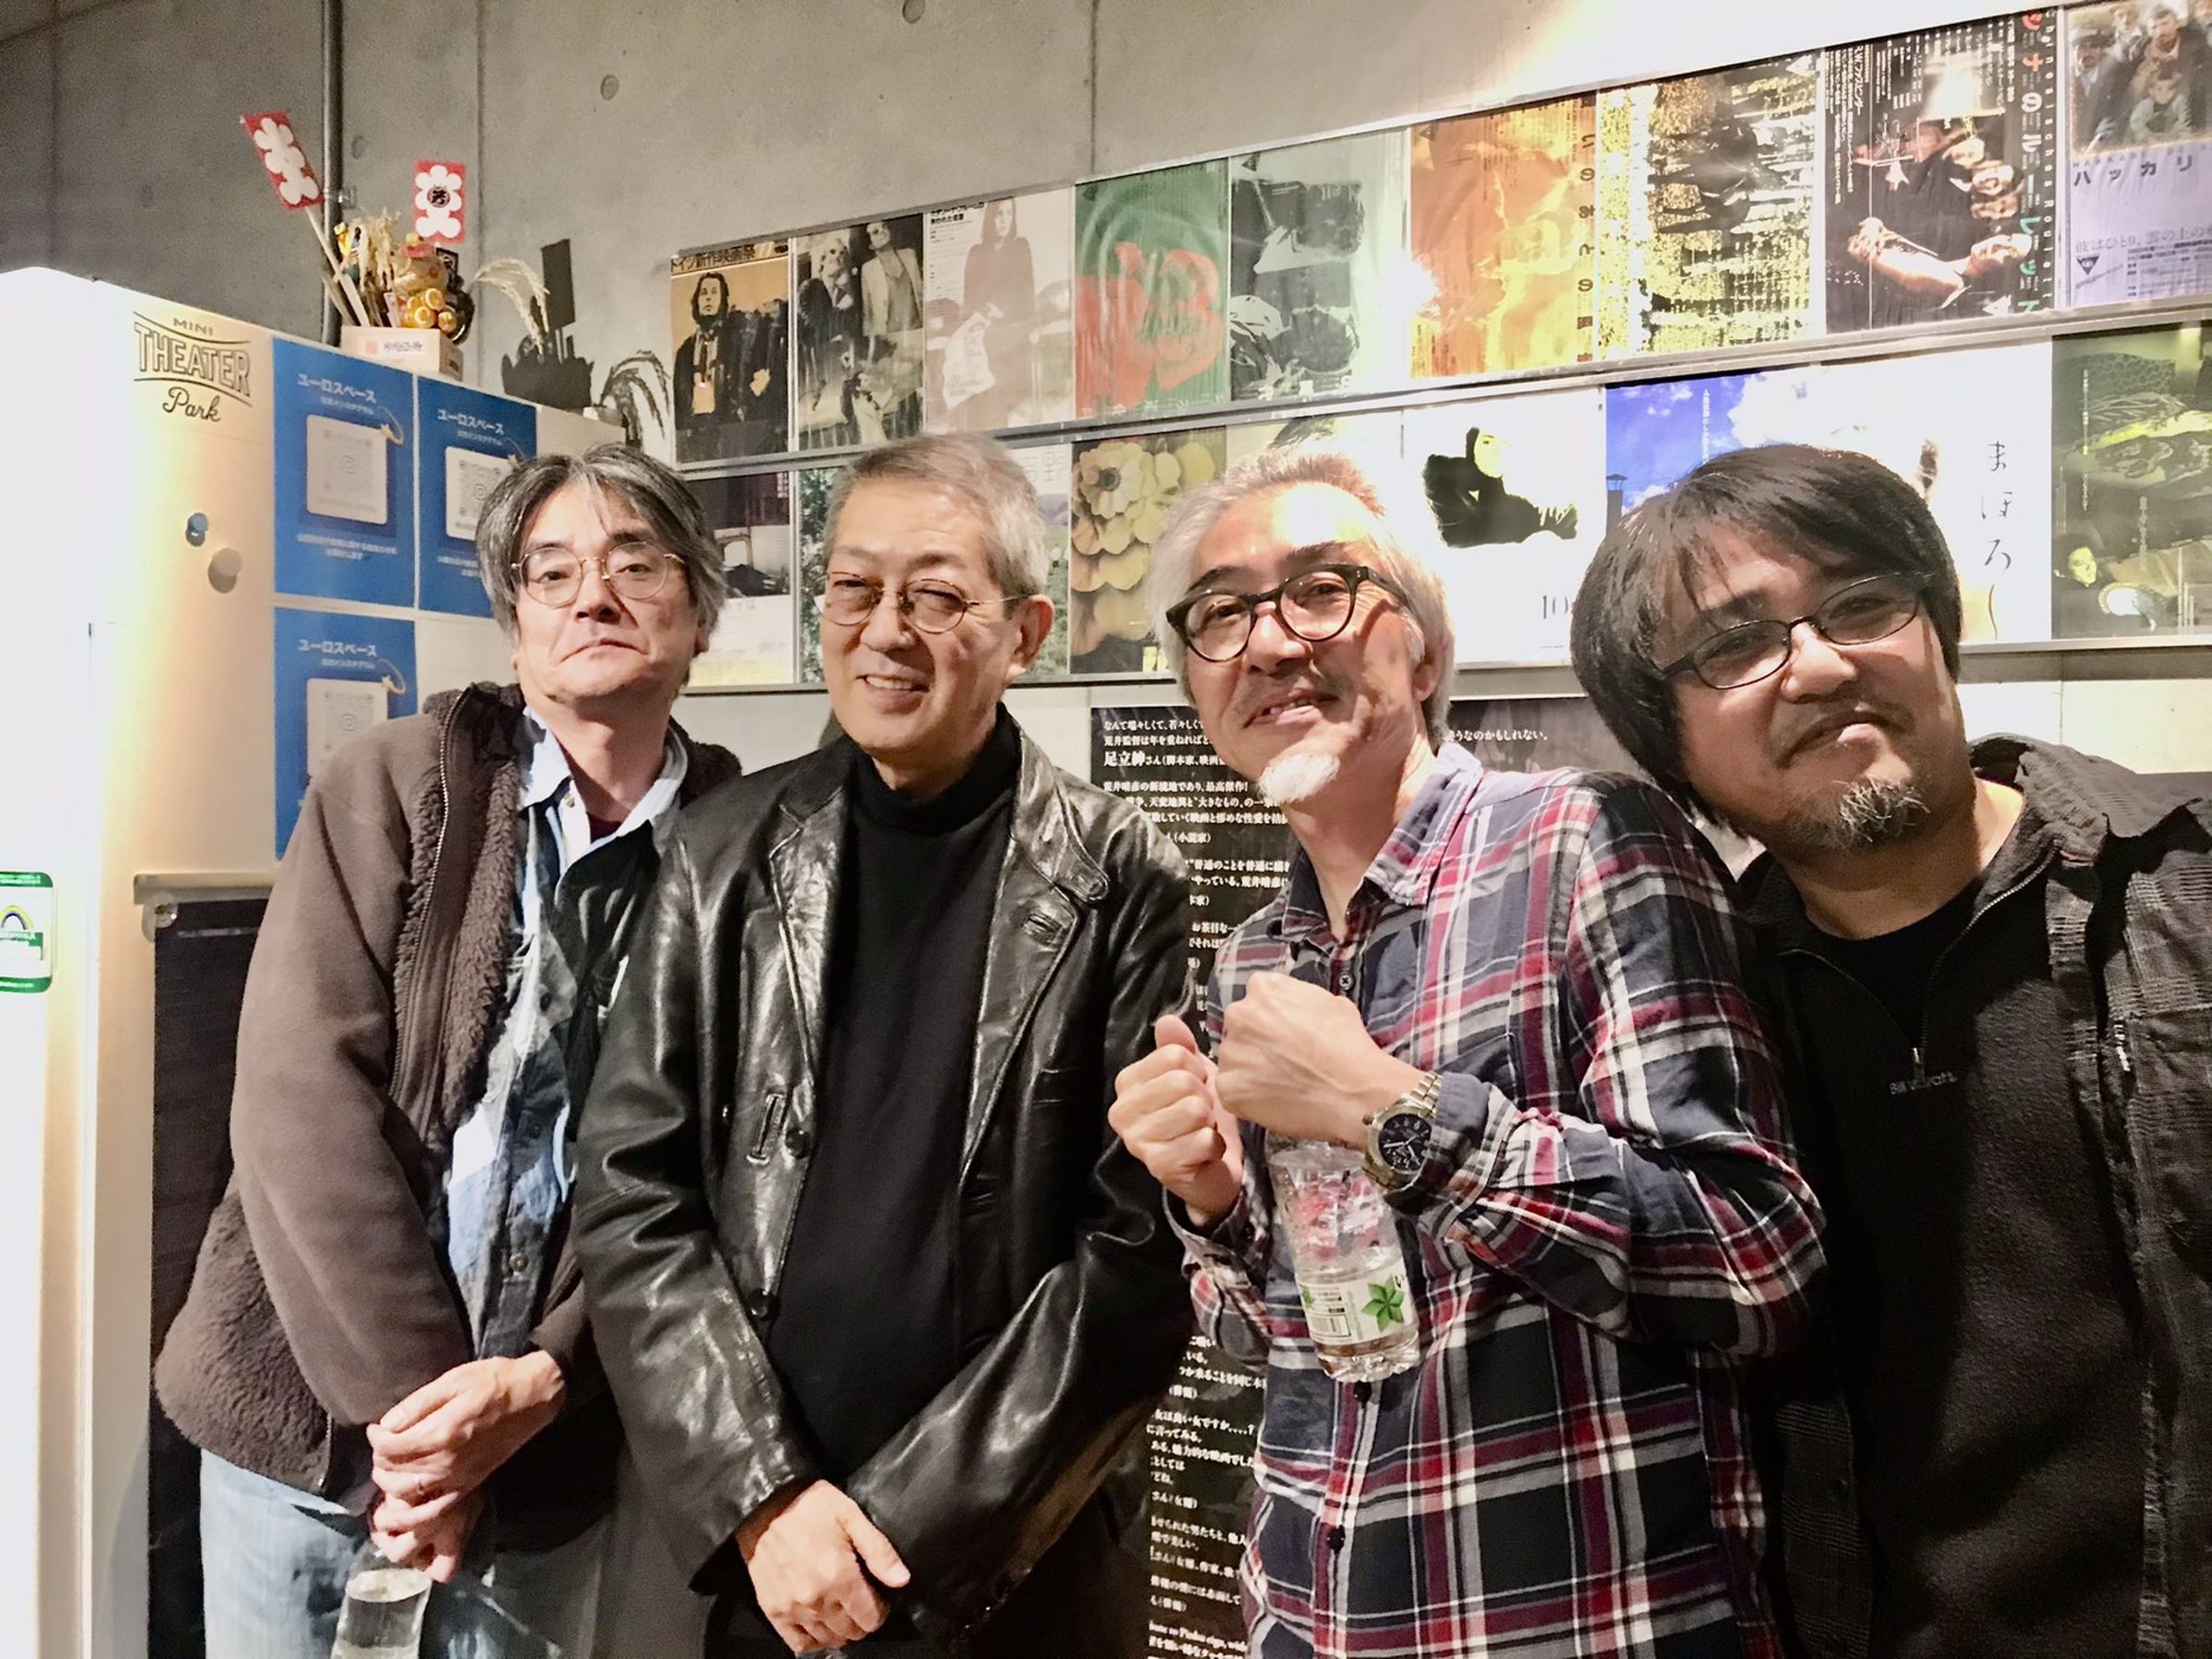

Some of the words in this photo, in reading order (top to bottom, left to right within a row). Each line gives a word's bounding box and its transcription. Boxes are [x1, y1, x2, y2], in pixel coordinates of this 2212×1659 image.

[2073, 155, 2193, 186] ハッカリ
[172, 317, 214, 336] MINI
[133, 321, 252, 398] THEATER
[161, 385, 222, 423] Park
[297, 372, 377, 405] ユーロスペース
[436, 408, 505, 436] ユーロスペース
[298, 638, 378, 658] ユーロスペース
